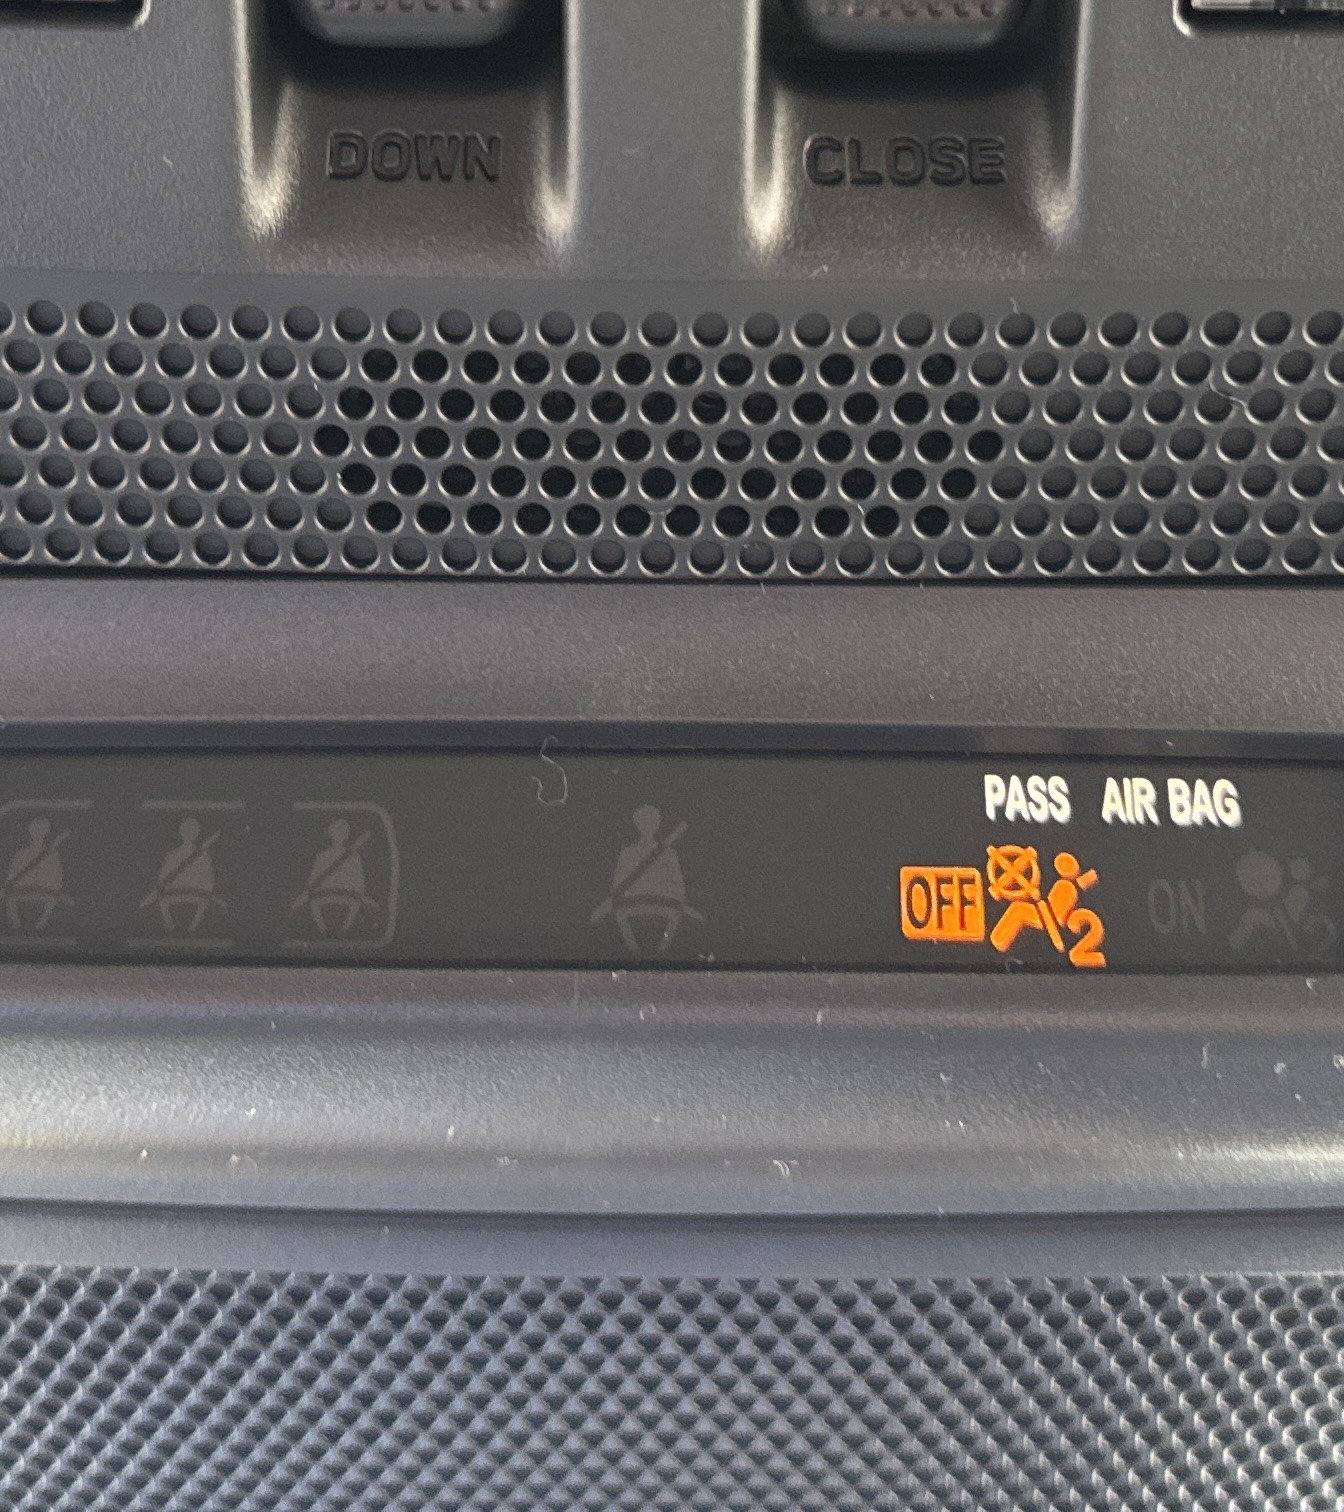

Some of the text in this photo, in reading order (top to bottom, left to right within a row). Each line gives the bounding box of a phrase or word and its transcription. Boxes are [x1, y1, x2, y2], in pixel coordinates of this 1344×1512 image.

[325, 131, 502, 182] DOWN
[801, 135, 1008, 187] CLOSE
[983, 774, 1243, 828] PASS AIR BAG
[904, 873, 980, 931] OFF
[1147, 878, 1208, 936] ON
[1067, 908, 1106, 969] 2
